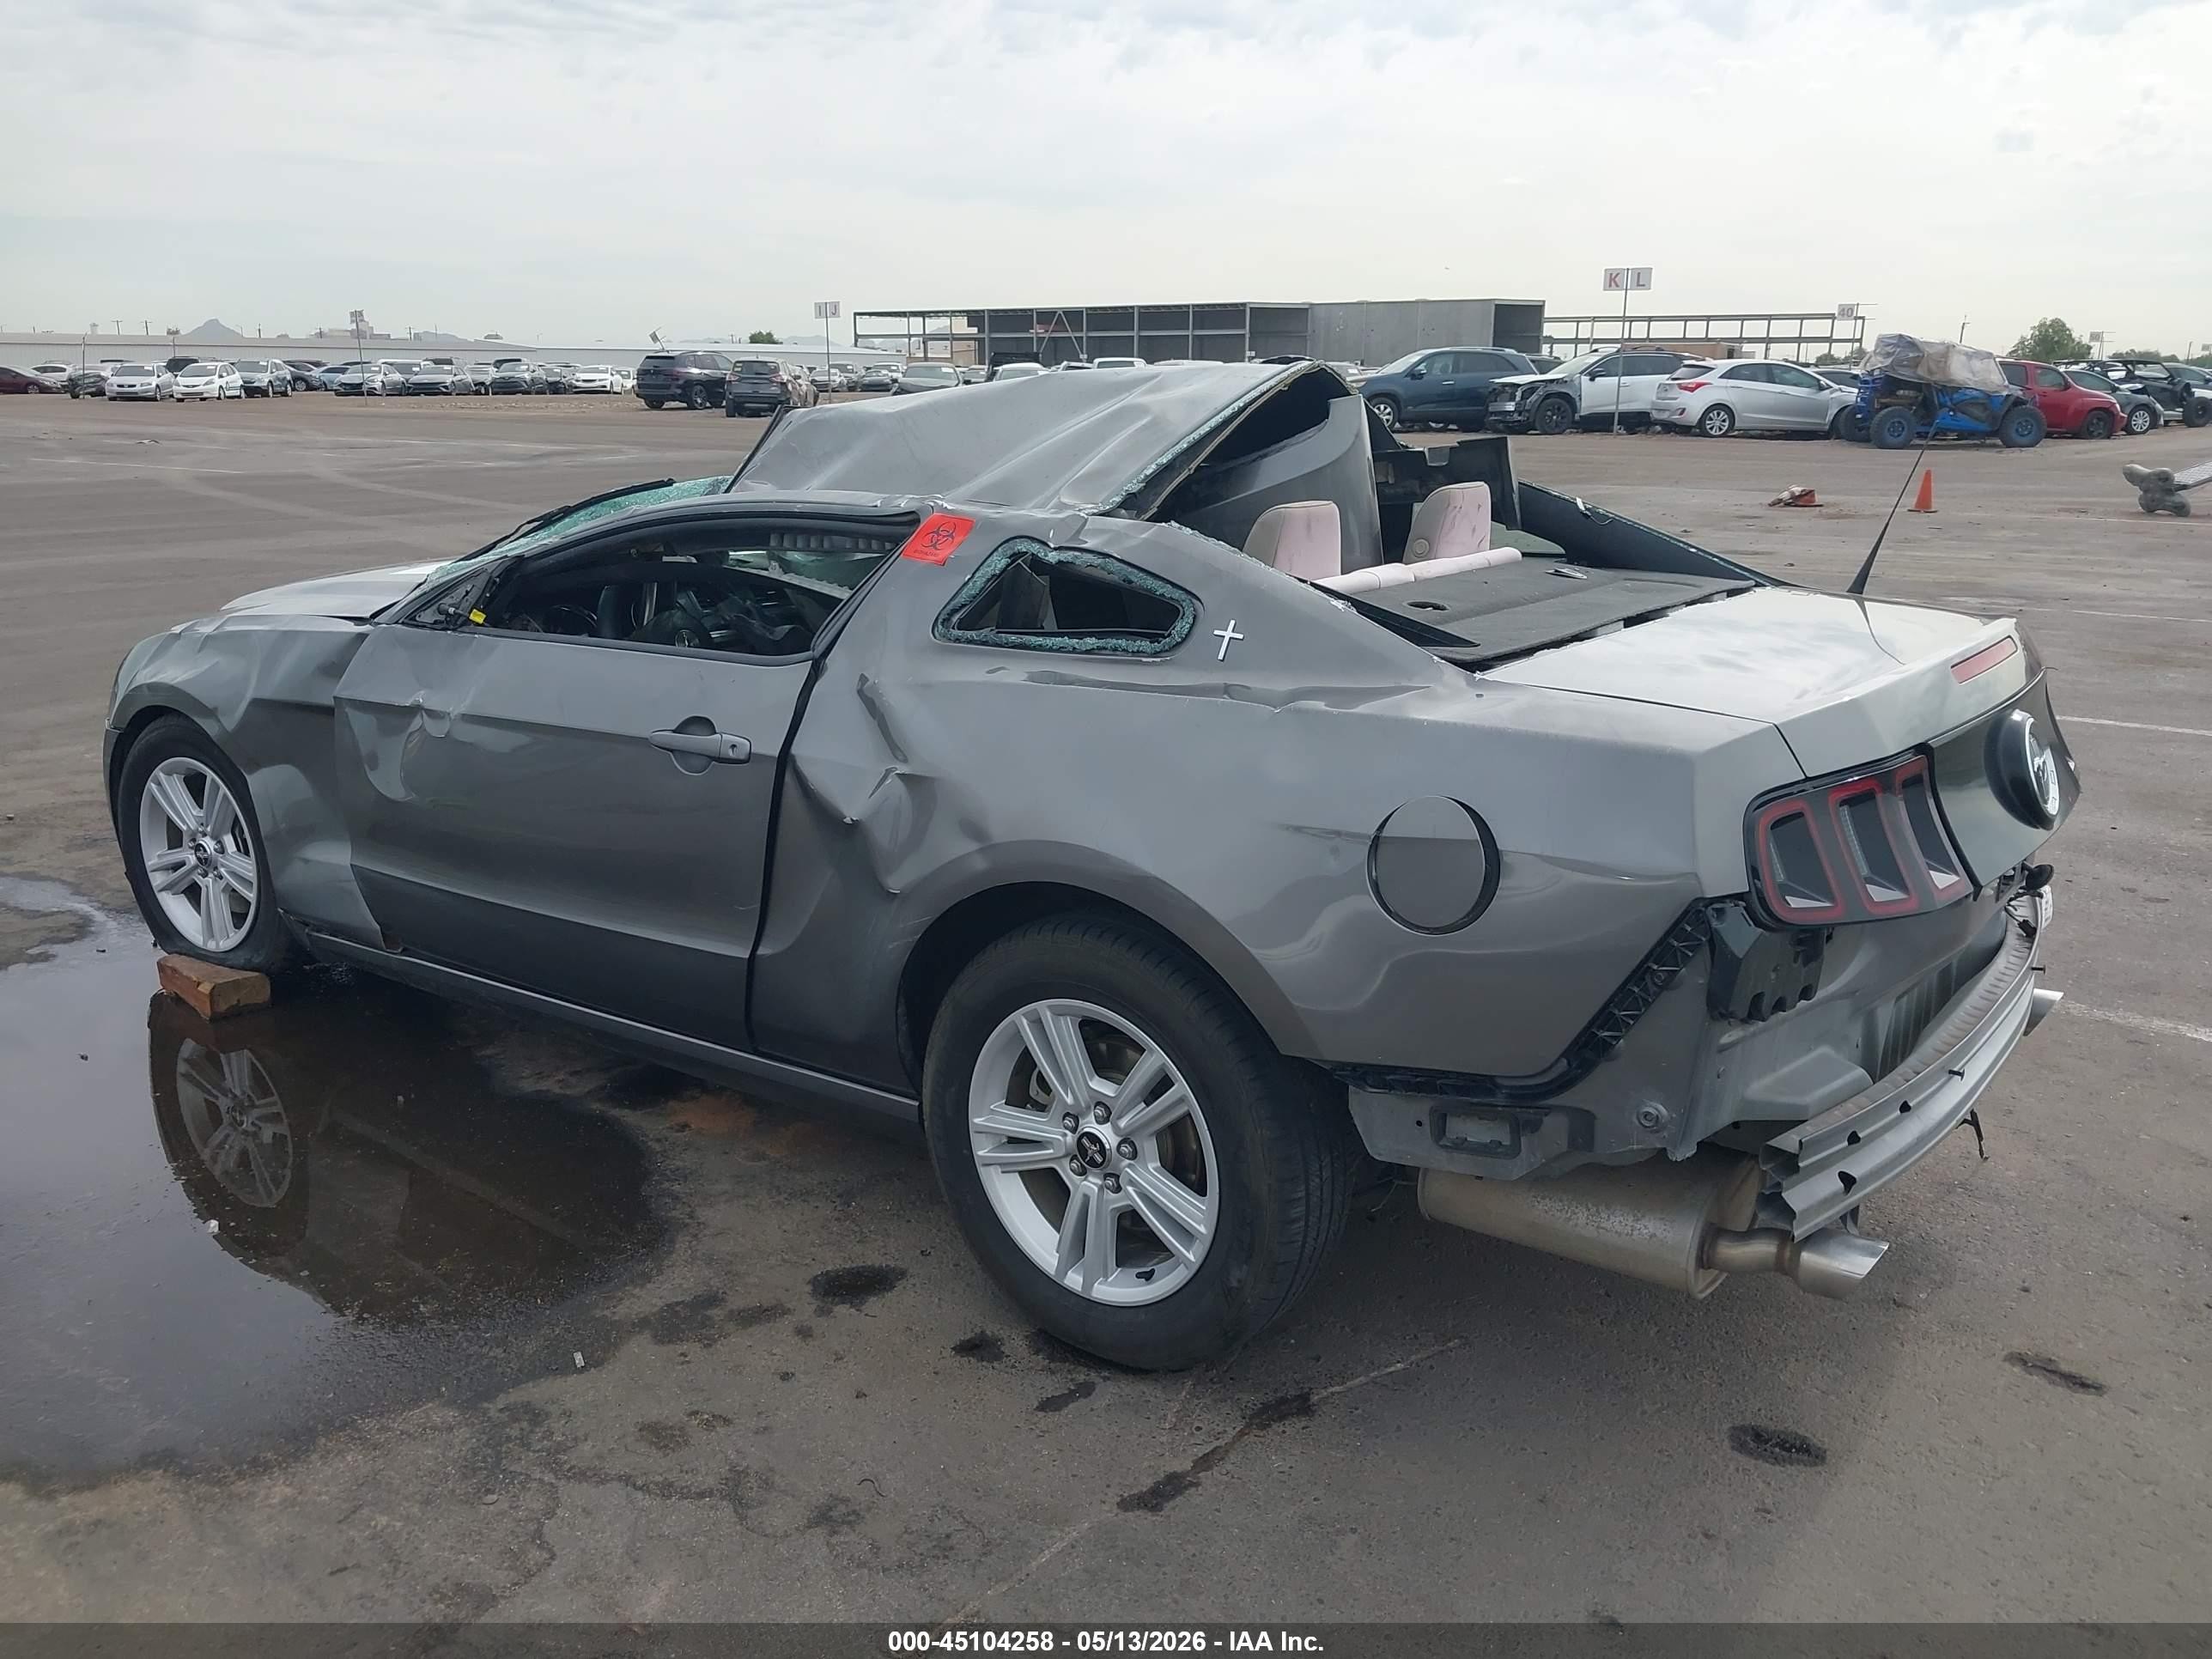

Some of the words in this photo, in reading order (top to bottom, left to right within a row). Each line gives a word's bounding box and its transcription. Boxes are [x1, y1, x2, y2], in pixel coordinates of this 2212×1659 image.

[1608, 271, 1621, 288] K
[1636, 271, 1646, 287] L
[830, 304, 837, 316] J
[1838, 307, 1854, 318] 40
